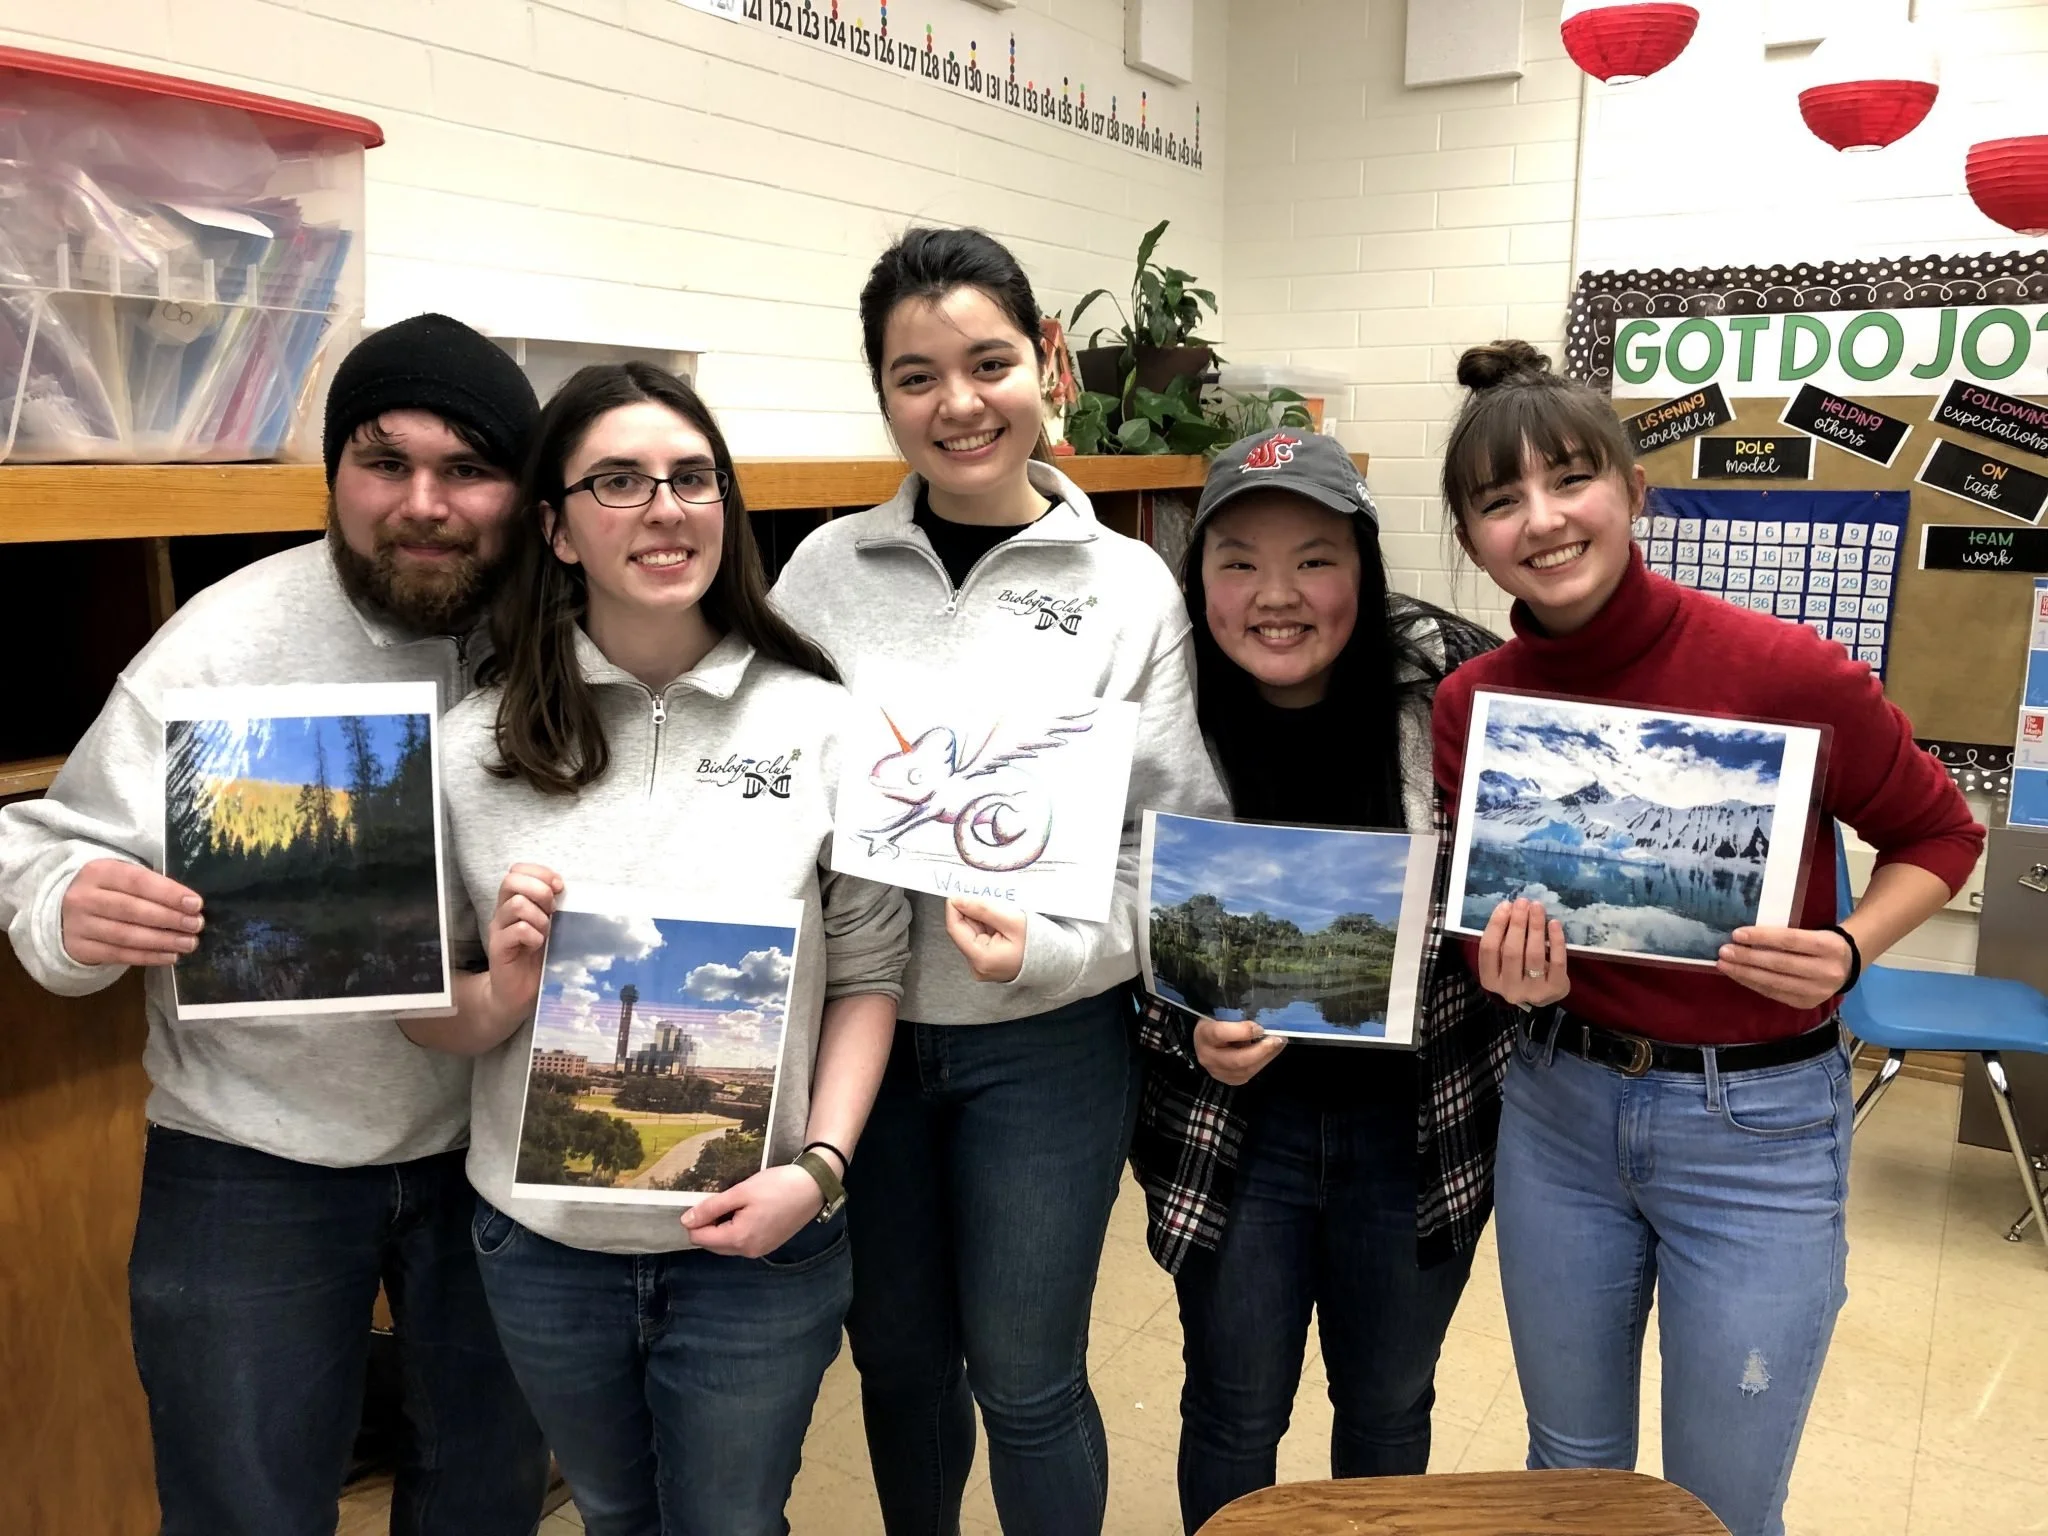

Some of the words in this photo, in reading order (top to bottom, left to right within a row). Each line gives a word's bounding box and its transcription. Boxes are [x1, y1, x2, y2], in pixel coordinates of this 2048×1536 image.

[743, 0, 762, 21] 121
[770, 0, 792, 31] 122
[798, 6, 819, 40] 123
[825, 16, 846, 49] 124
[850, 25, 870, 57] 125
[874, 33, 894, 65] 126
[898, 42, 917, 71] 127
[921, 50, 939, 80] 128
[943, 58, 960, 86] 129
[965, 65, 982, 93] 130
[986, 73, 1000, 101] 131
[1005, 80, 1020, 107] 132
[1023, 87, 1038, 113] 133
[1040, 93, 1055, 120] 134
[1058, 100, 1072, 125] 135
[1075, 106, 1089, 131] 136
[1091, 111, 1104, 136] 137
[1107, 118, 1119, 142] 138
[1121, 123, 1134, 147] 139
[1136, 128, 1150, 151] 140
[1152, 133, 1163, 156] 141
[1165, 138, 1176, 161] 142
[1178, 143, 1190, 166] 143
[1190, 148, 1202, 170] 144
[1614, 316, 1770, 384] GOT
[1639, 410, 1715, 449] carefully
[1814, 416, 1866, 446] others
[1943, 405, 2048, 450] expectations
[1726, 456, 1780, 473] model
[1981, 463, 2008, 480] ON
[1963, 475, 2002, 500] task
[1660, 522, 1668, 533] 2
[1685, 523, 1694, 534] 3
[1711, 524, 1720, 536] 4
[1739, 525, 1747, 537] 5
[1765, 526, 1774, 538] 6
[1794, 527, 1801, 538] 7
[1819, 528, 1829, 540] 8
[1850, 528, 1859, 540] 9
[1877, 530, 1893, 542] 10
[1654, 545, 1668, 556] 12
[1681, 546, 1694, 558] 13
[1707, 548, 1720, 559] 14
[1735, 550, 1748, 561] 15
[1762, 551, 1776, 562] 16
[1788, 551, 1800, 563] 17
[1816, 551, 1831, 564] 18
[1844, 553, 1857, 564] 19
[1873, 554, 1891, 566] 20
[1963, 549, 2013, 566] work
[1678, 569, 1695, 581] 23
[1704, 571, 1720, 583] 24
[1730, 572, 1747, 584] 25
[1759, 574, 1775, 585] 26
[1785, 575, 1800, 587] 27
[1813, 576, 1830, 588] 28
[1841, 577, 1859, 589] 29
[1870, 579, 1888, 591] 30
[997, 589, 1046, 615] Biology
[1051, 598, 1084, 613] Club
[1730, 595, 1746, 607] 35
[1753, 598, 1769, 609] 36
[1782, 598, 1796, 610] 37
[1809, 600, 1827, 612] 38
[1839, 601, 1856, 613] 39
[1867, 602, 1885, 614] 40
[1835, 627, 1853, 638] 49
[1864, 628, 1881, 639] 50
[1860, 651, 1878, 662] 60
[696, 753, 749, 787] Biology
[756, 755, 791, 774] Club
[933, 869, 1016, 901] WALLACE
